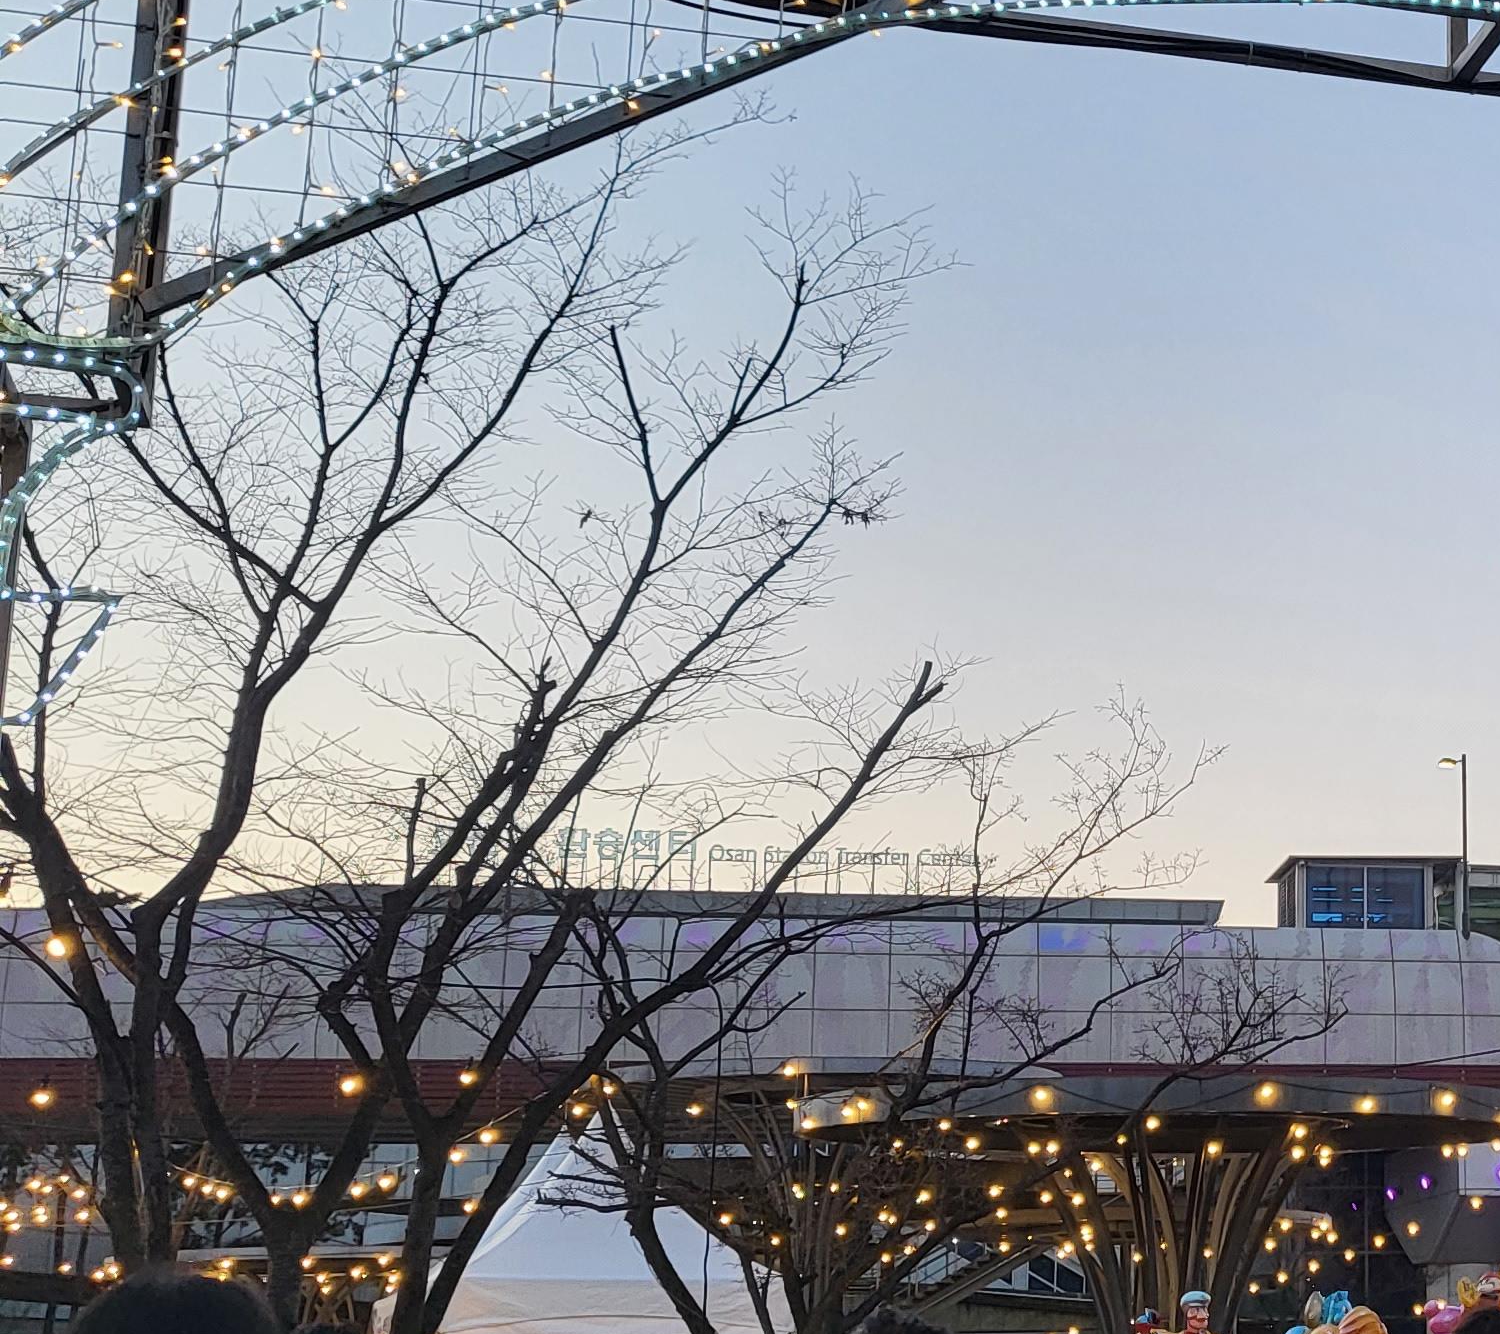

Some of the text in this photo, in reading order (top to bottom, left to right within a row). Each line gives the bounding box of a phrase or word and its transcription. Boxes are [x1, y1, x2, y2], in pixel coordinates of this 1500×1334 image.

[709, 844, 757, 862] Osan
[764, 845, 829, 864] Staon
[836, 847, 909, 865] Transfer
